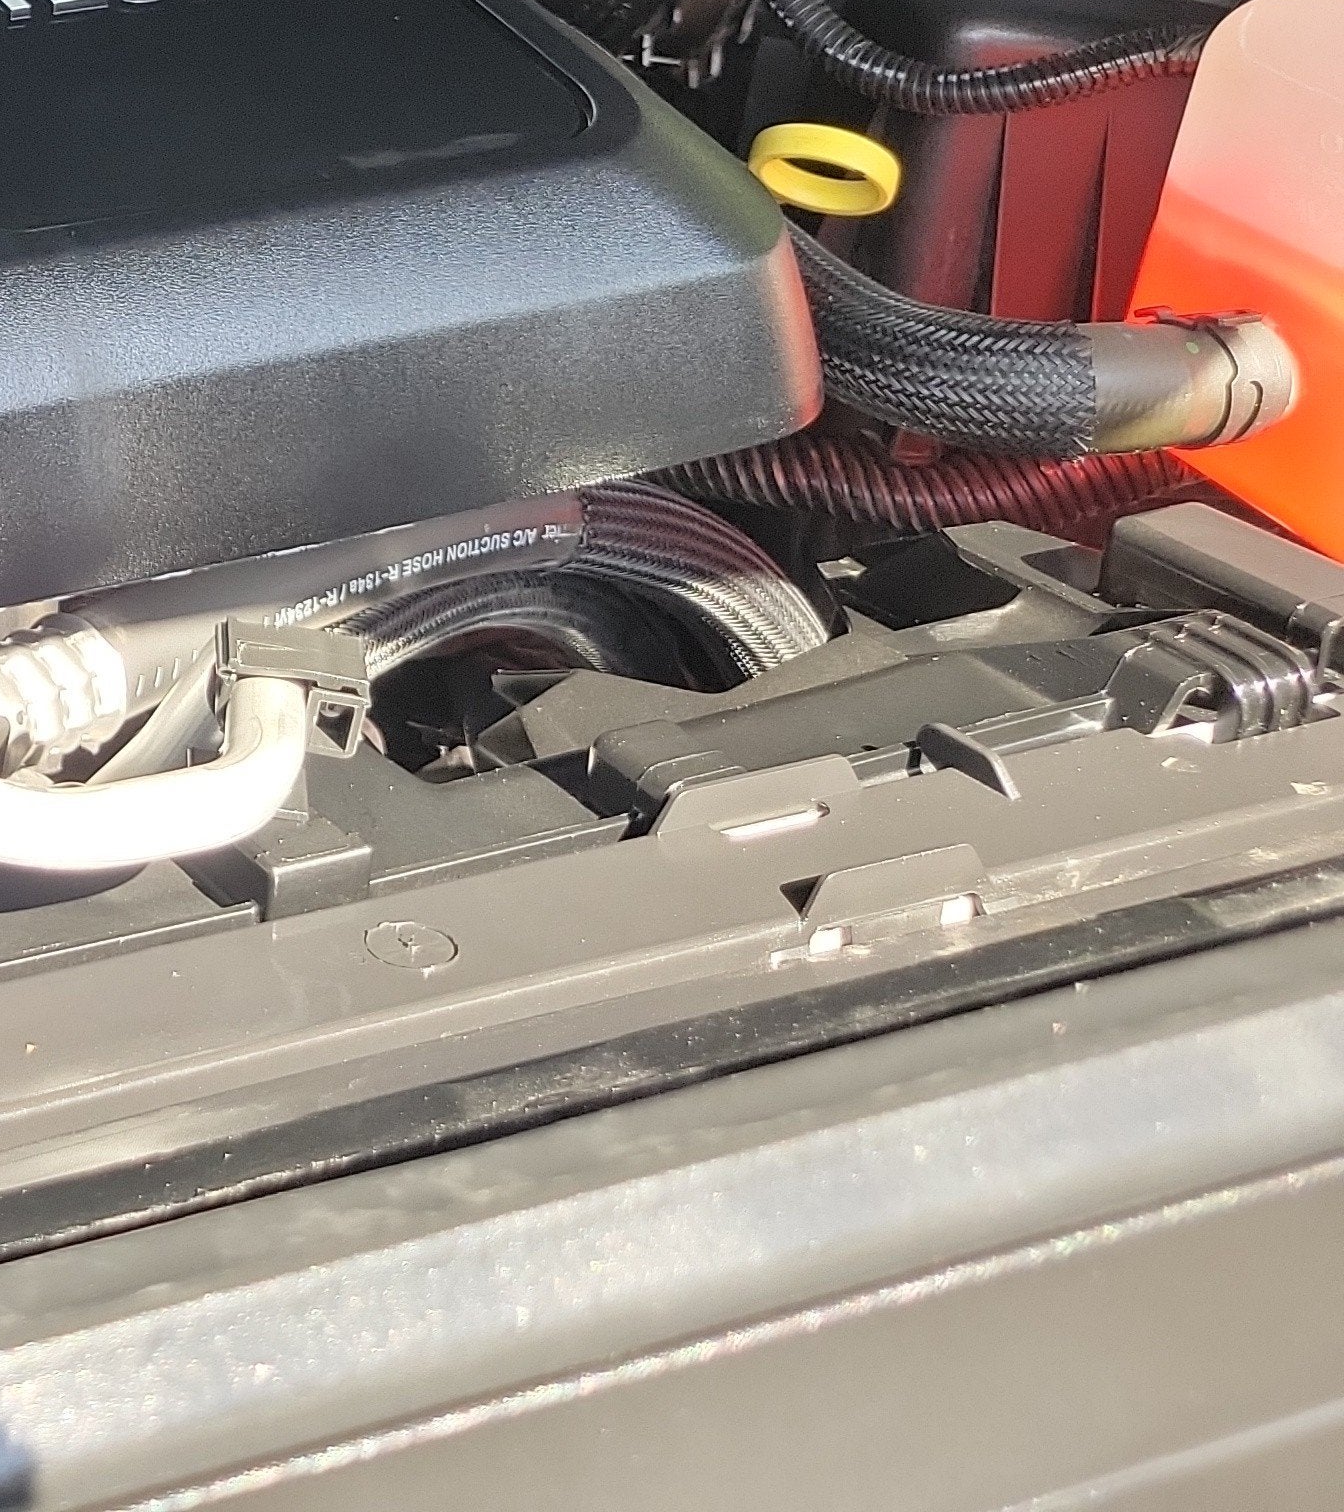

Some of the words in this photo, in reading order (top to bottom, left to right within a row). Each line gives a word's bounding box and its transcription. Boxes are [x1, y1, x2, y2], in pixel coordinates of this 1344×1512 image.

[446, 532, 511, 563] SUCTION
[513, 527, 538, 547] A/C
[401, 548, 444, 576] HOSE
